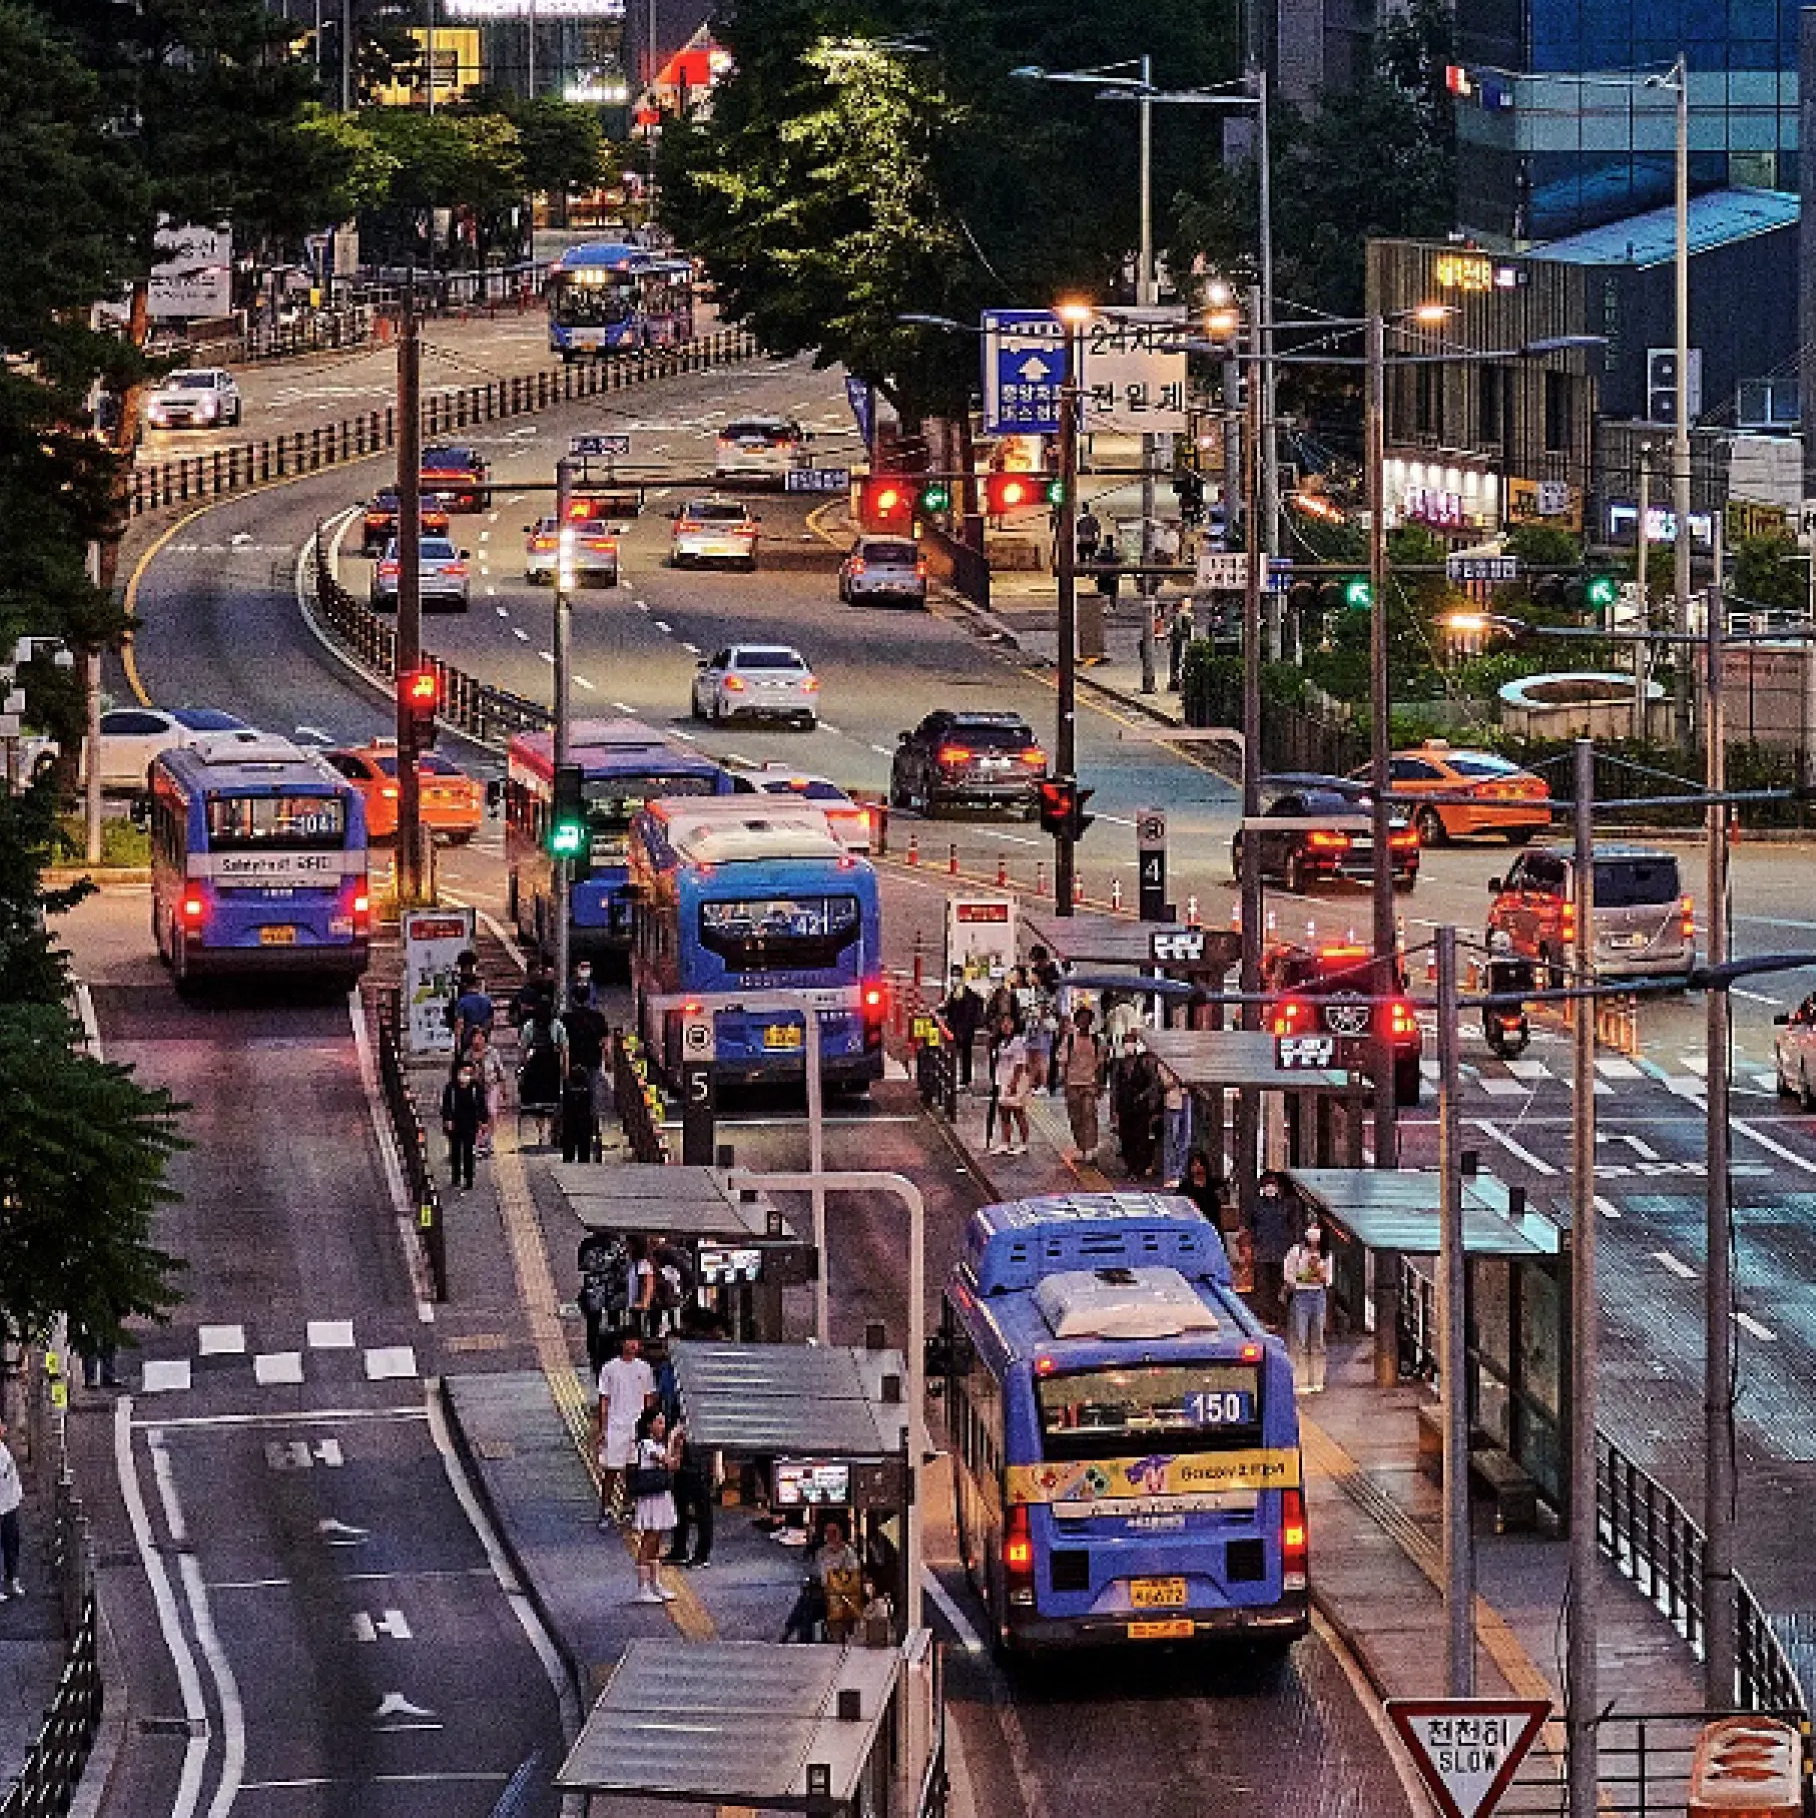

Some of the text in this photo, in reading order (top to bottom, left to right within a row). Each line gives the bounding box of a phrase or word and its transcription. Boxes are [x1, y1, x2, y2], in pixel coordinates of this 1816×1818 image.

[1144, 857, 1159, 882] 4
[691, 1072, 708, 1100] 5
[1191, 1393, 1241, 1423] 150
[1427, 1719, 1511, 1747] 천천히
[1439, 1751, 1497, 1773] SLOW
